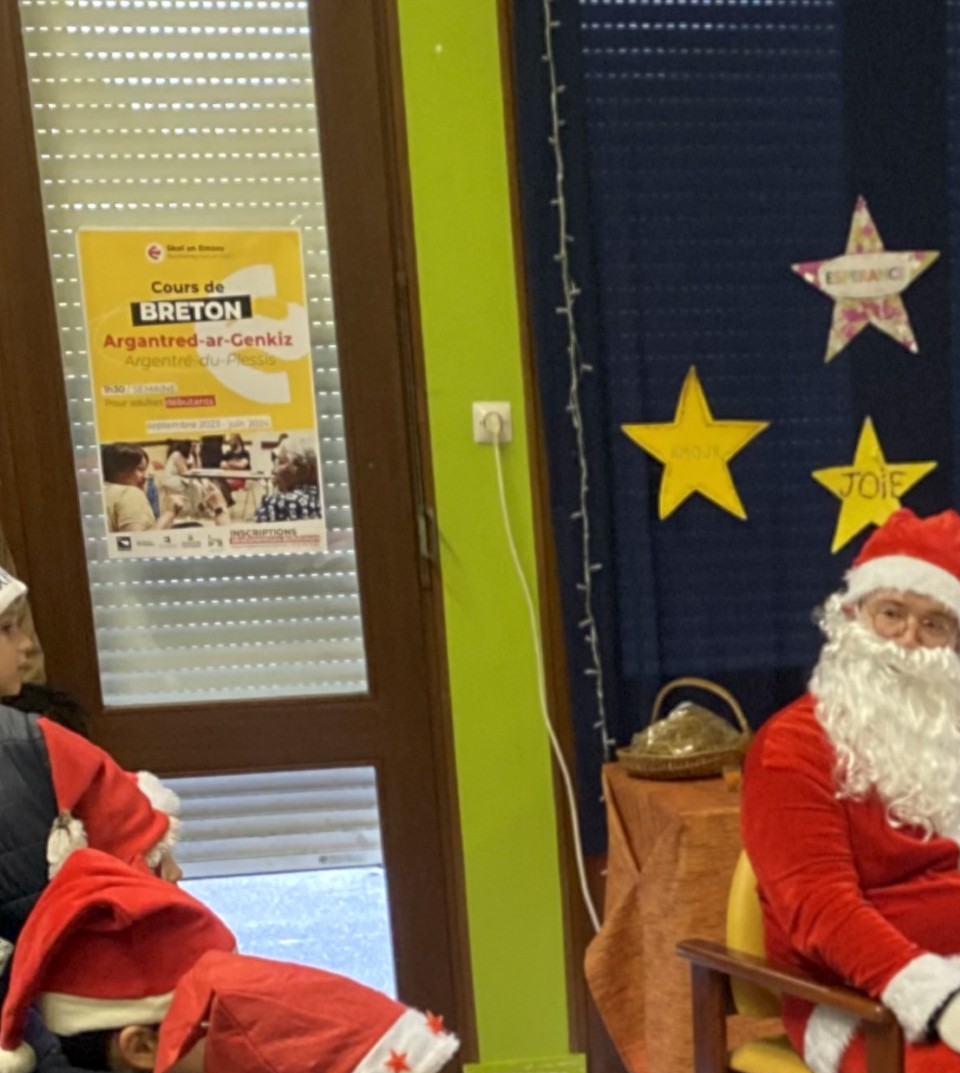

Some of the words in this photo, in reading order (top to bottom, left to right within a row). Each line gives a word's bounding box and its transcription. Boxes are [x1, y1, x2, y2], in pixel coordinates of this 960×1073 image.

[151, 281, 199, 294] Cours
[204, 280, 225, 293] de
[139, 300, 242, 322] BRETON
[103, 331, 294, 351] Argantred-ar-Genkiz
[124, 352, 276, 371] Argentré-du-Plessis
[103, 385, 125, 394] 1h30
[230, 528, 297, 537] INSCRIPTIONS
